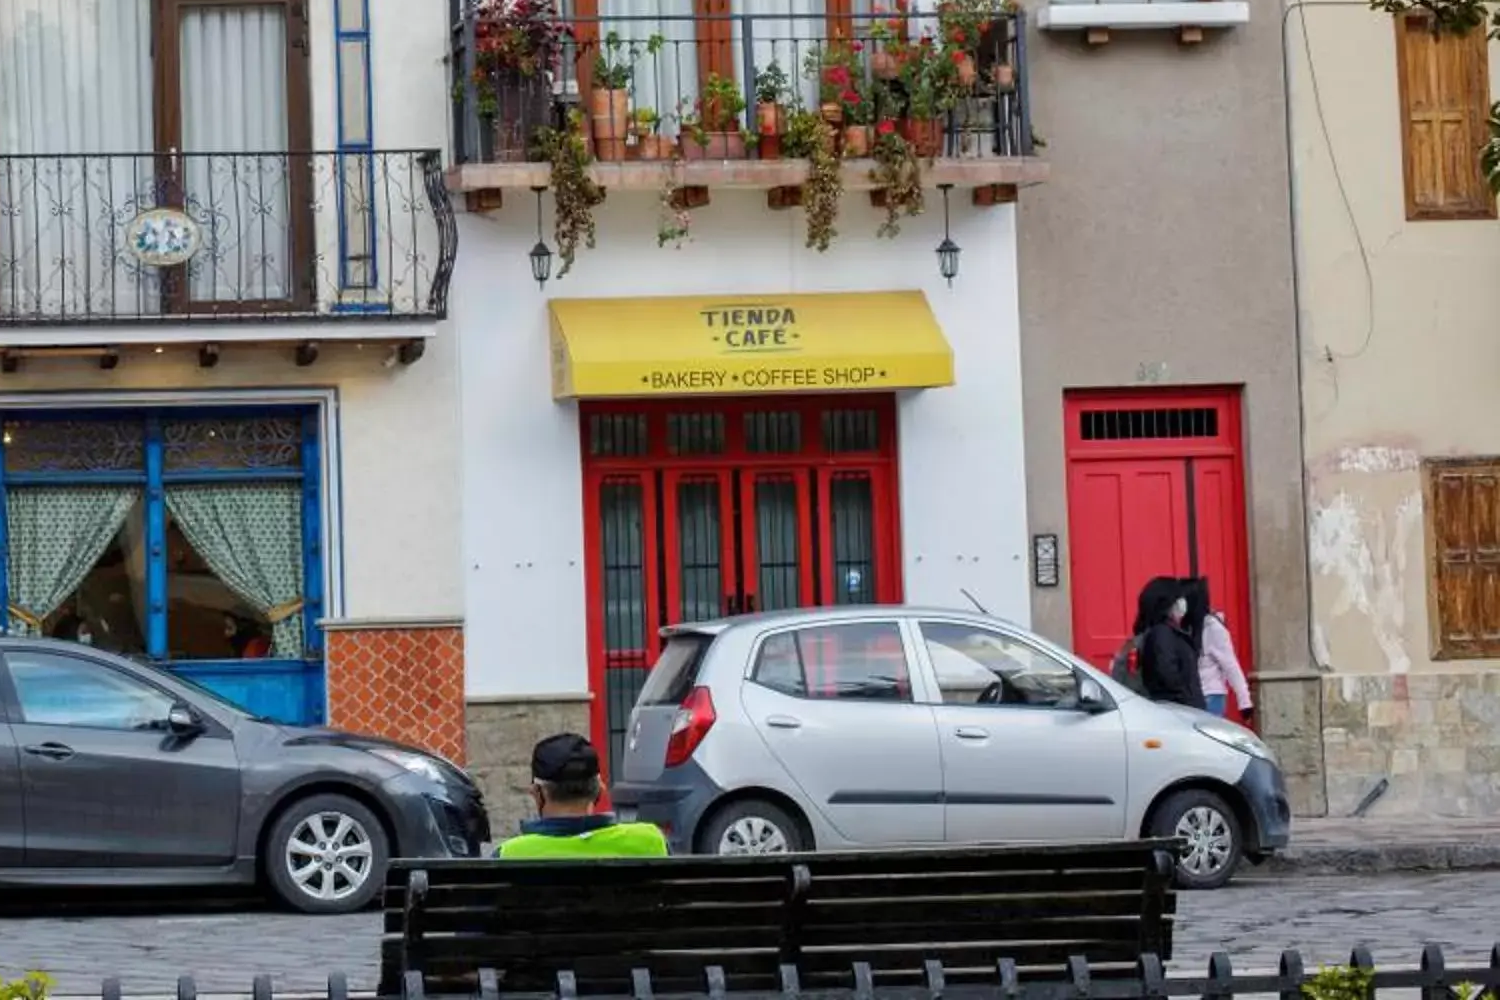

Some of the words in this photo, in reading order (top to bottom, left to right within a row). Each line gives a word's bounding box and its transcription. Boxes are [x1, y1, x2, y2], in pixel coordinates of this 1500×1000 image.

[700, 308, 796, 327] TIENDA
[651, 370, 727, 389] BAKERY
[742, 368, 818, 387] COFFEE
[822, 366, 876, 385] SHOP
